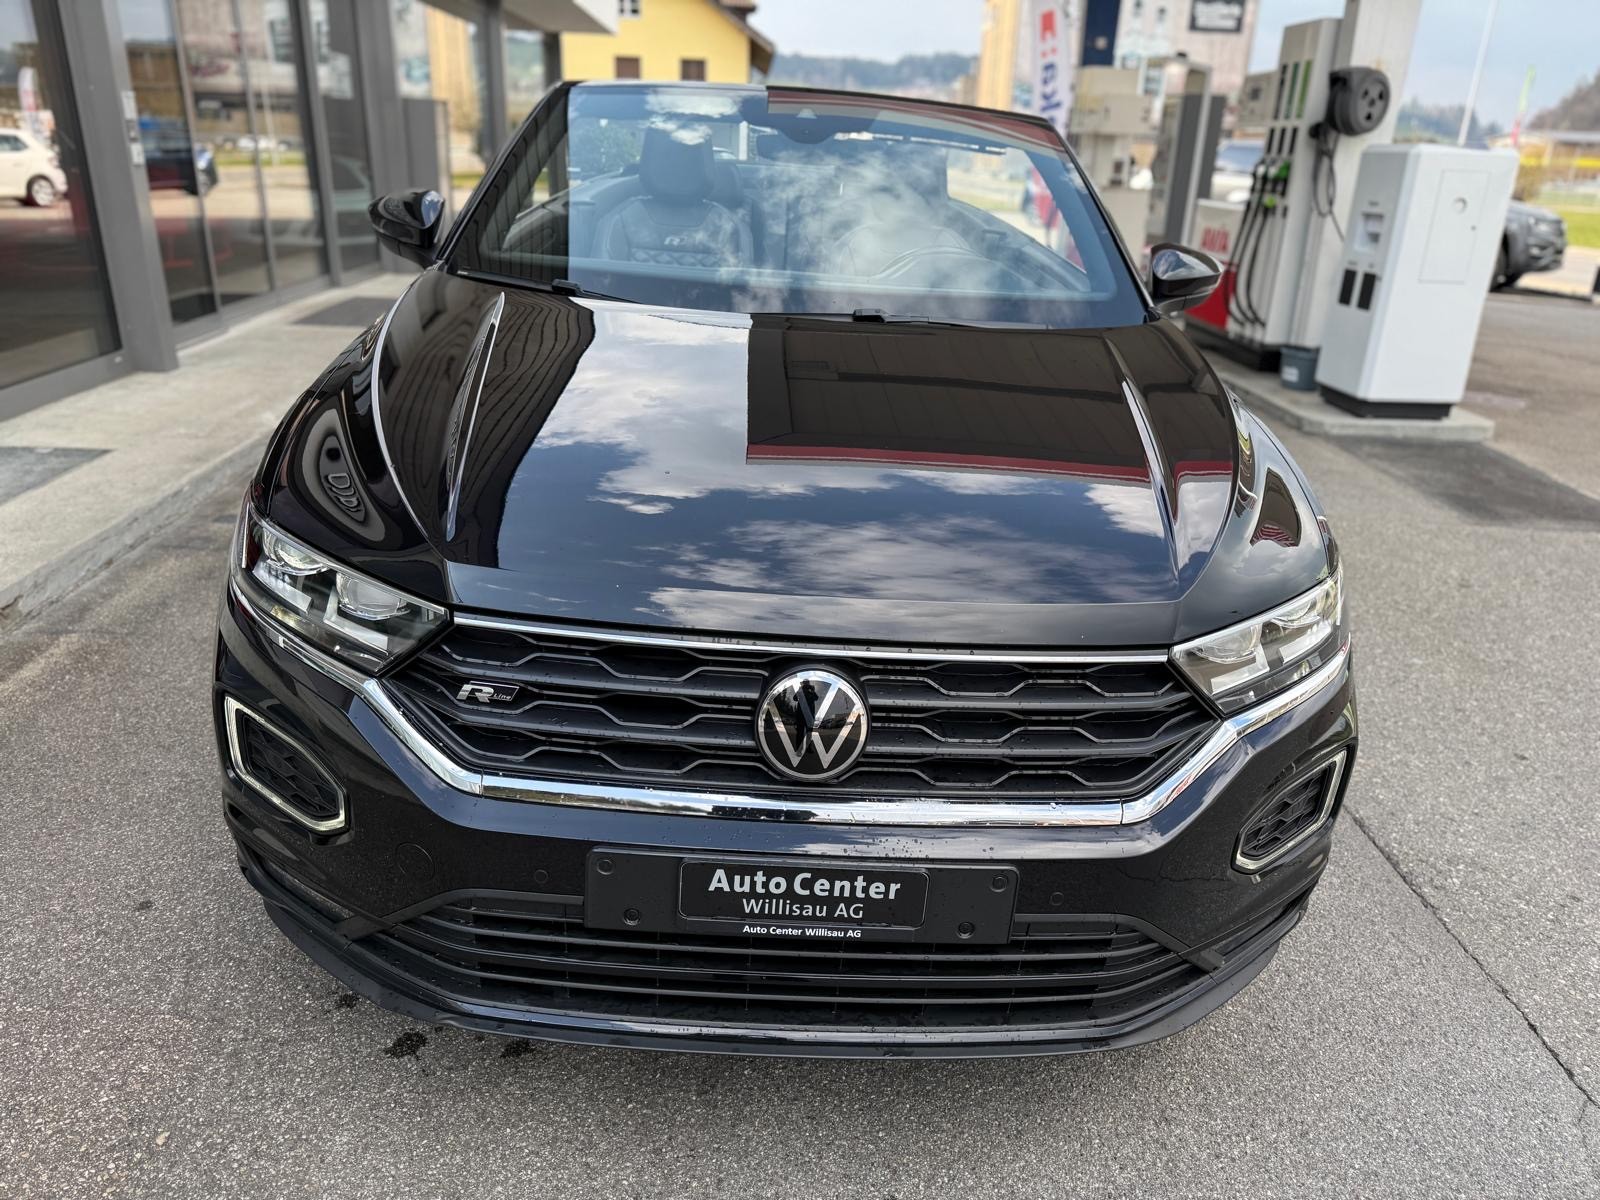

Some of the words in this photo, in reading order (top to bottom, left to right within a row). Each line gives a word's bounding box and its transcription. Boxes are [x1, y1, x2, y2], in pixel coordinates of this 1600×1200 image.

[708, 868, 787, 895] Auto
[793, 872, 901, 900] Center
[742, 898, 827, 917] Willisau
[833, 902, 864, 919] AG
[742, 925, 767, 935] Auto
[769, 926, 803, 936] Center
[805, 927, 844, 937] Willisau
[846, 929, 862, 938] AG
